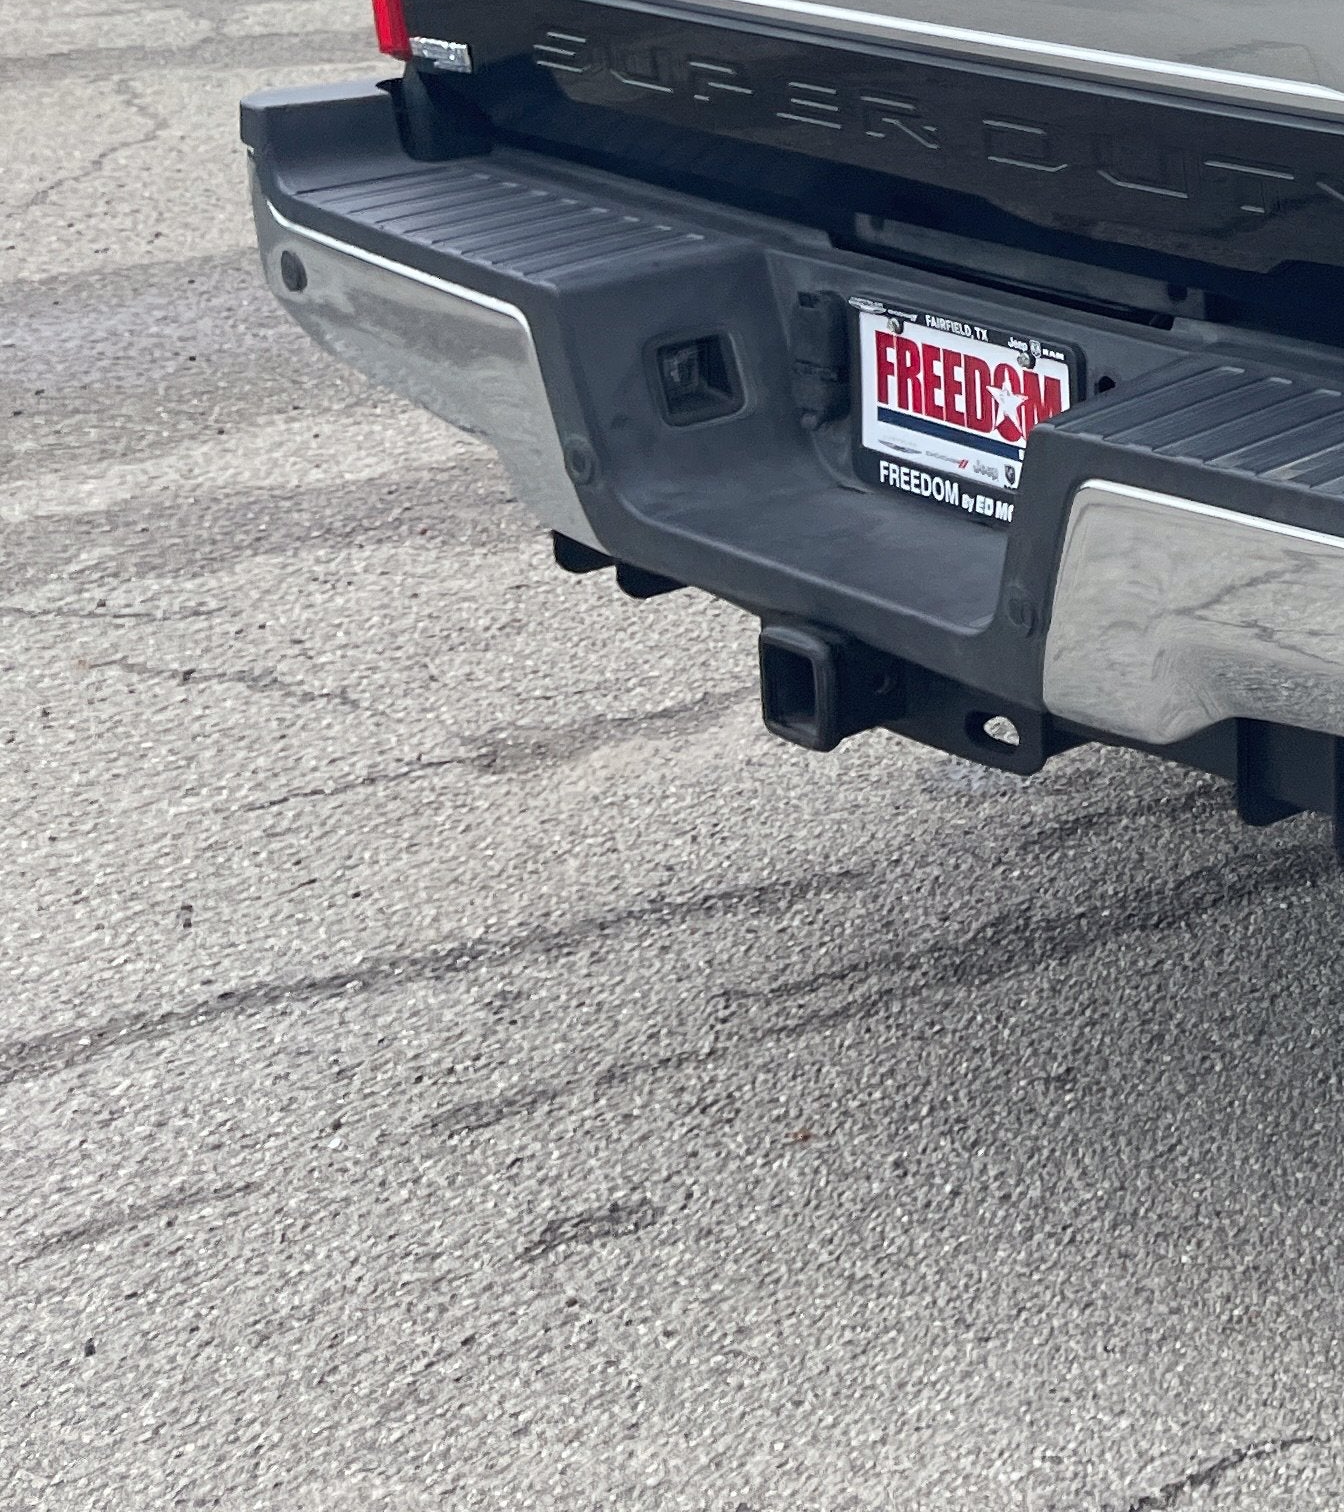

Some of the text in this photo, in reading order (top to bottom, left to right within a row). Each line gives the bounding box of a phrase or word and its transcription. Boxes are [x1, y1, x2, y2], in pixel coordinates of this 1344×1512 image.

[532, 30, 940, 151] SUPER
[925, 314, 974, 340] FAIRFIELD,
[974, 326, 989, 343] TX
[874, 330, 1062, 442] FREEDOM
[879, 460, 959, 506] FREEDOM
[975, 494, 994, 516] ED
